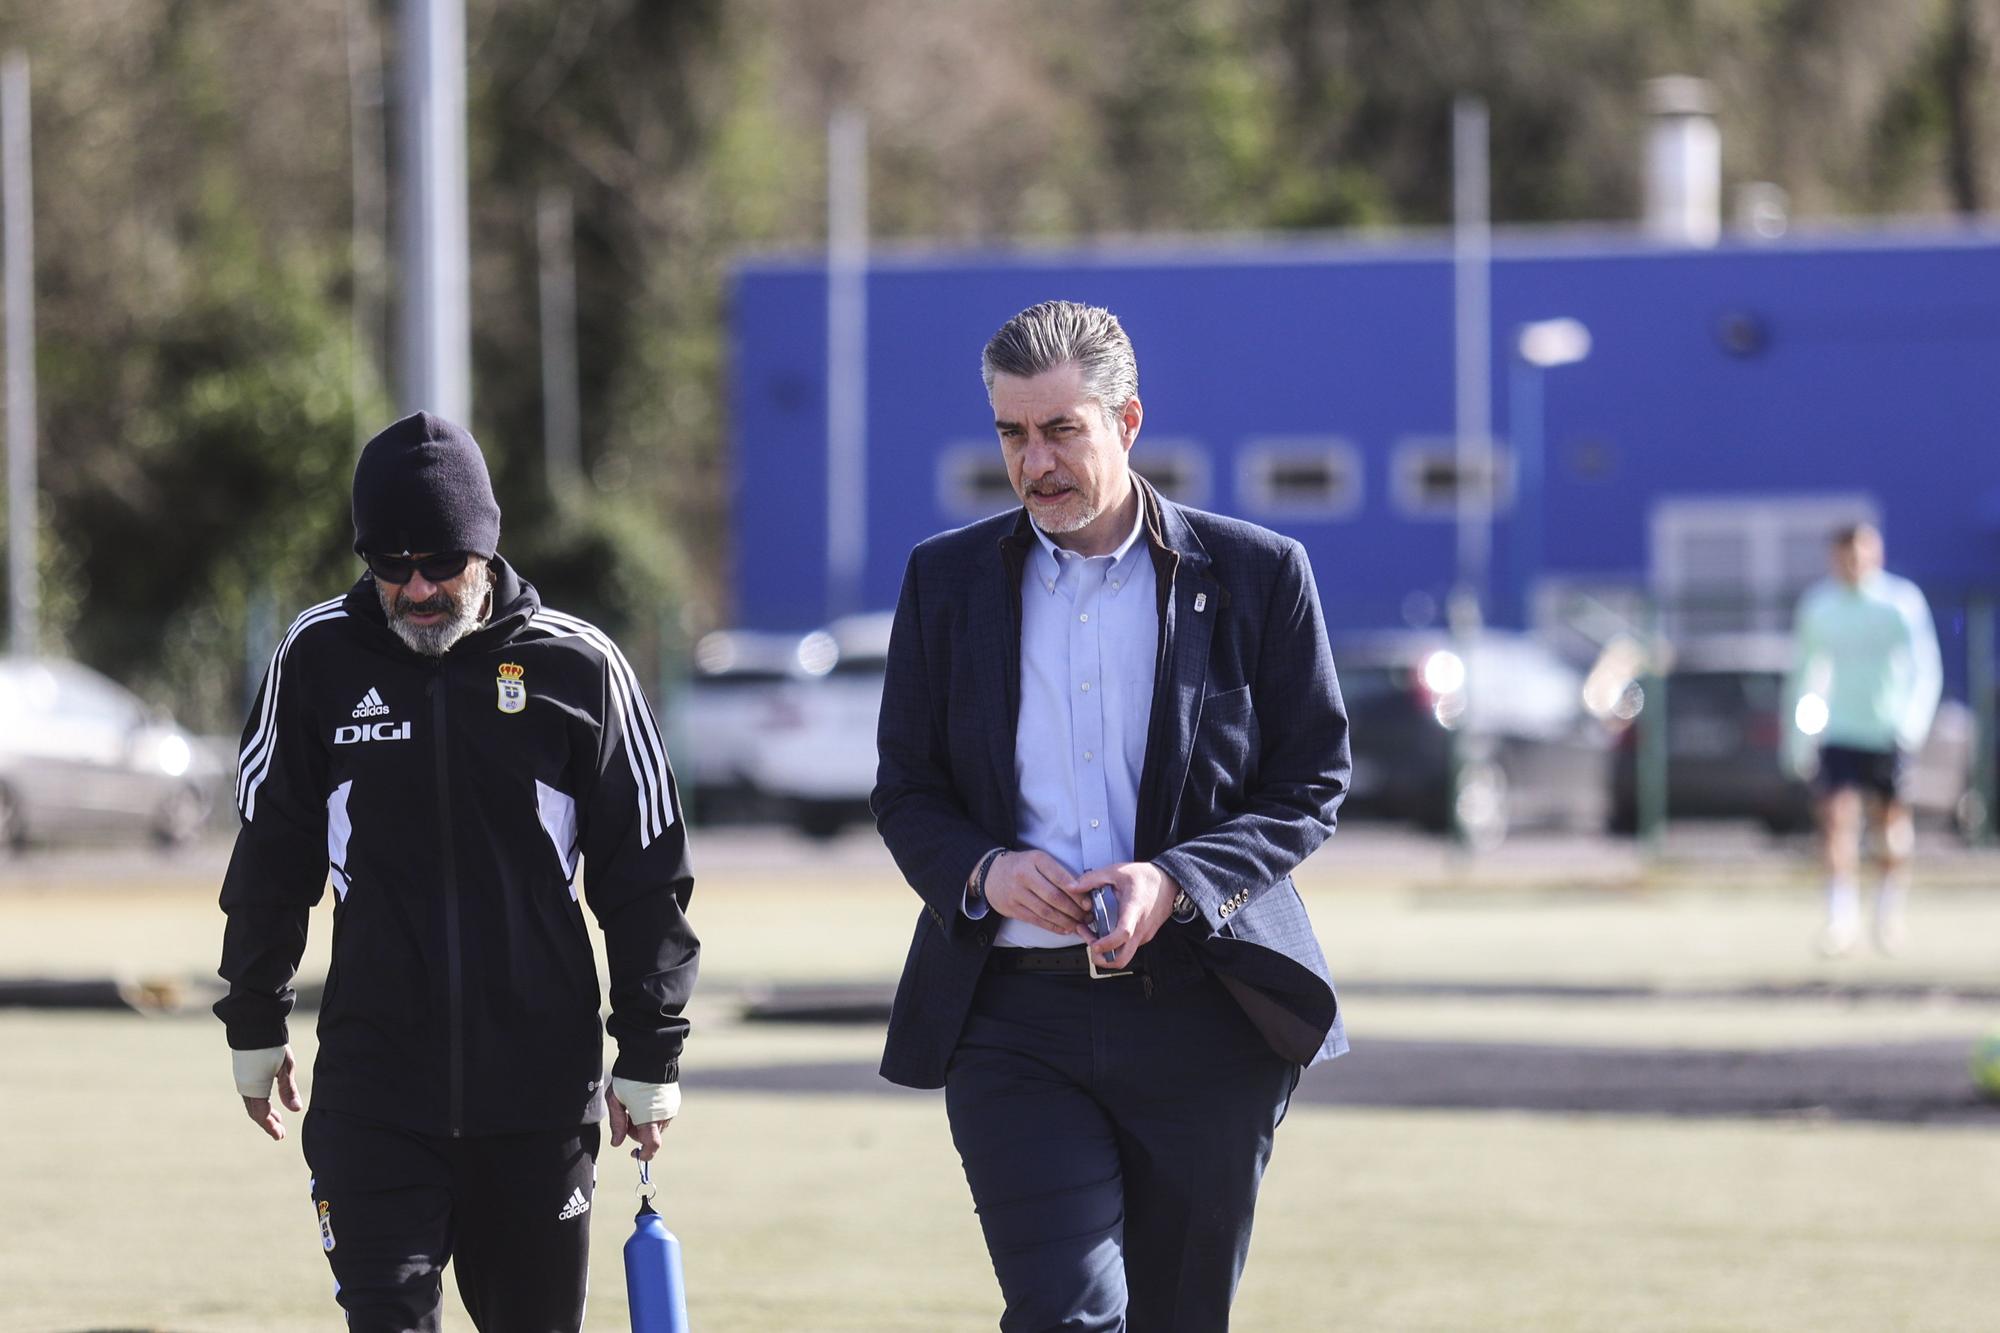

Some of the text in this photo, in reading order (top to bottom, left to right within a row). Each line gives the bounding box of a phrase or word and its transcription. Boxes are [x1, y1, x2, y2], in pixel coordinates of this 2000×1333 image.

[352, 705, 390, 718] adidas
[334, 721, 411, 744] DIGI
[559, 1201, 590, 1220] adidas
